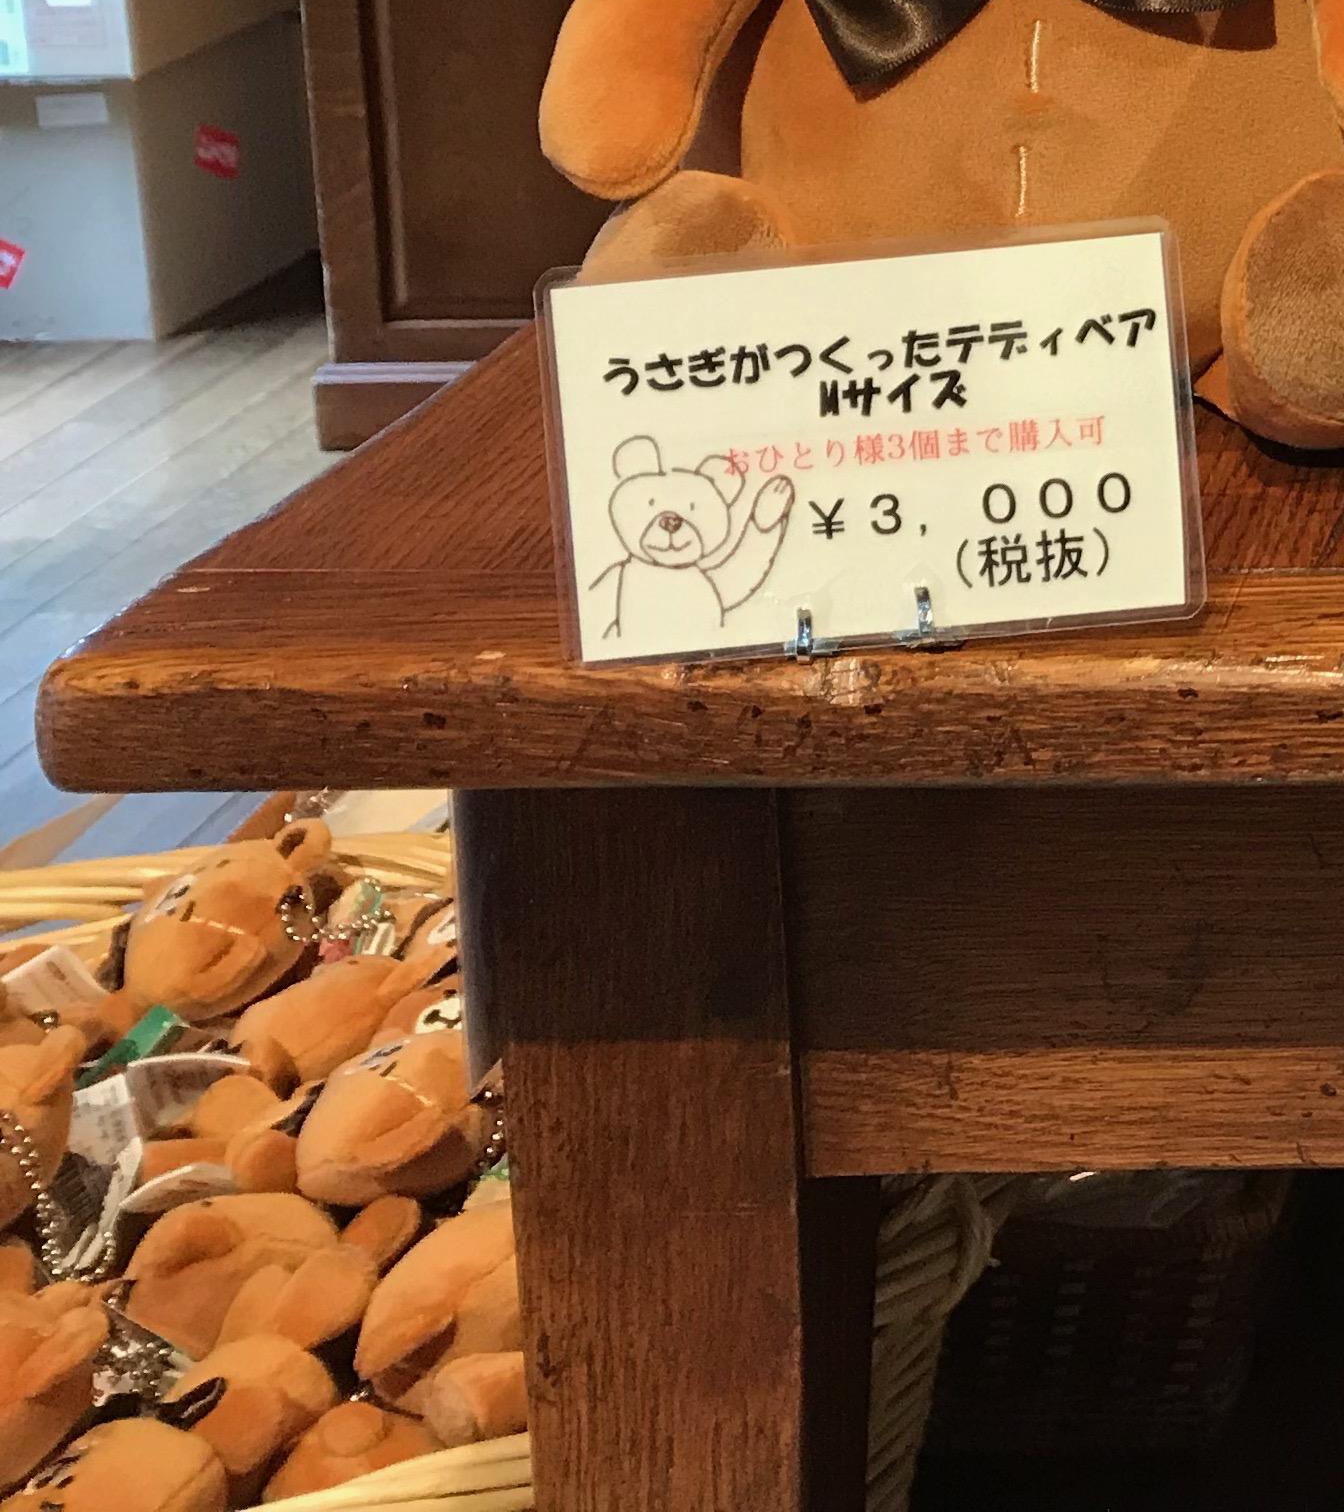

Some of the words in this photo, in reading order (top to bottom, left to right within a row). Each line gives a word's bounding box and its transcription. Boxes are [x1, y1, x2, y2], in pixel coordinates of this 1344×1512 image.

[602, 308, 1158, 396] うさぎがつくったテディベア
[819, 369, 969, 419] Mサイズ
[722, 414, 1107, 477] おひとり様3個まで購入可
[955, 527, 1111, 589] (税抜)
